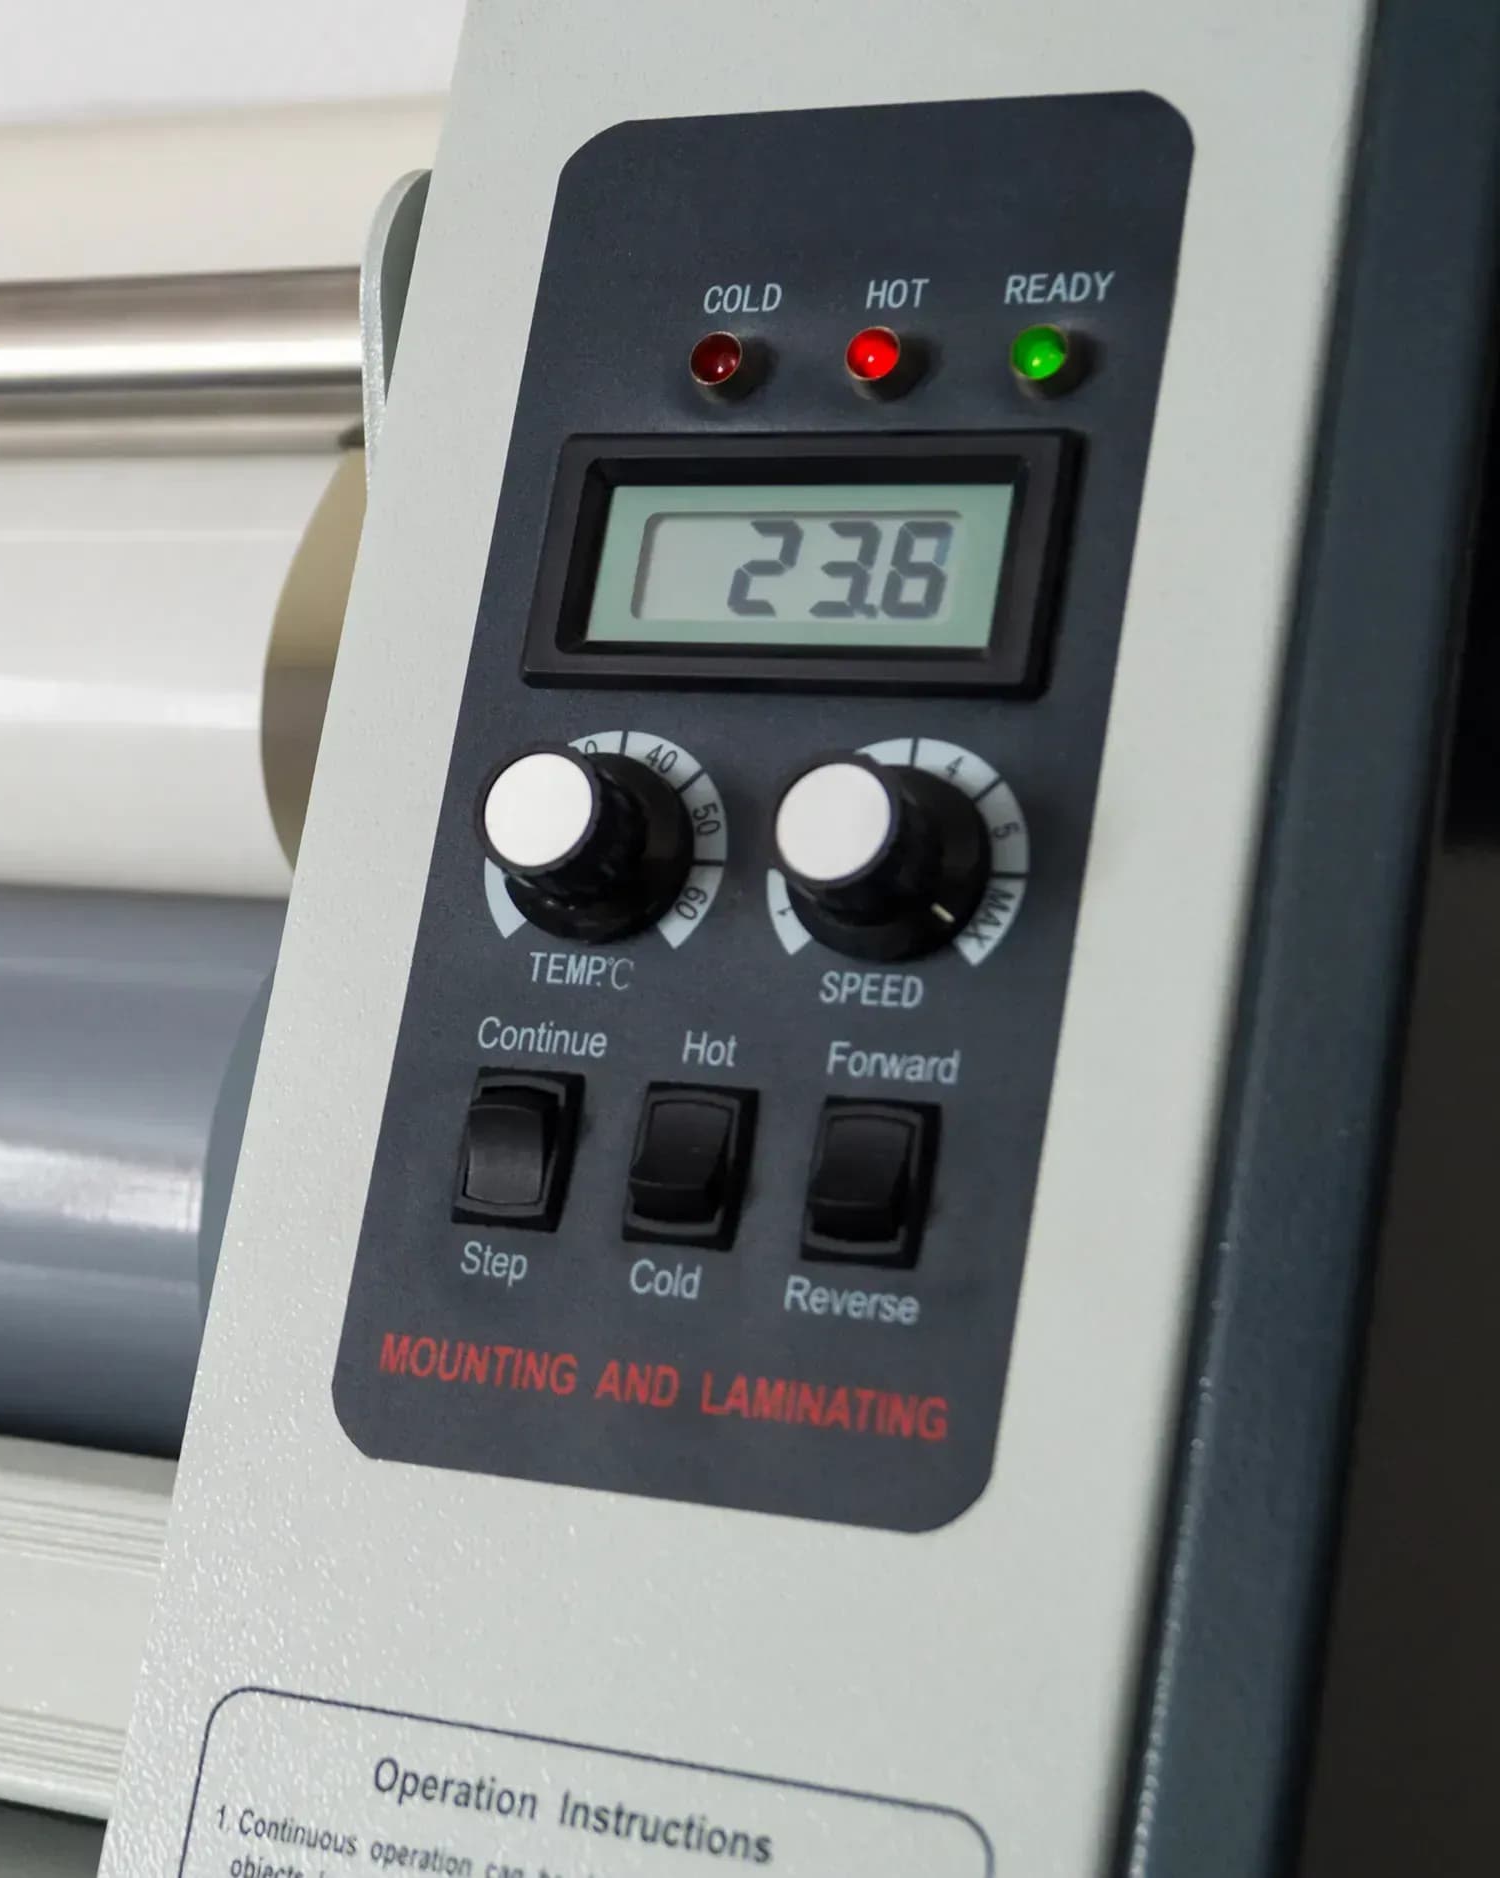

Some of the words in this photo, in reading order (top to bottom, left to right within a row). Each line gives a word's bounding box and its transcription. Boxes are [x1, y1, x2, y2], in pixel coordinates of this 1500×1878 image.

[703, 283, 783, 314] COLD
[865, 278, 930, 309] HOT
[1003, 271, 1114, 305] READY
[645, 744, 679, 774] 40
[945, 756, 964, 777] 4
[693, 802, 720, 836] 50
[992, 821, 1020, 840] 5
[675, 887, 707, 921] 60
[963, 888, 1016, 949] MAX
[819, 970, 924, 1009] SPEED
[477, 1015, 608, 1058] Continue
[682, 1030, 737, 1068] Hot
[826, 1040, 961, 1084] Forward
[460, 1240, 528, 1287] Step
[629, 1258, 702, 1300] Cold
[783, 1274, 920, 1325] Reverse
[379, 1332, 578, 1396] MOUNTING
[595, 1360, 680, 1408] AND
[699, 1372, 949, 1441] LAMINATING
[374, 1757, 538, 1820] Operation
[558, 1790, 773, 1865] Instructions
[239, 1808, 358, 1857] Continuous
[370, 1841, 473, 1877] operation
